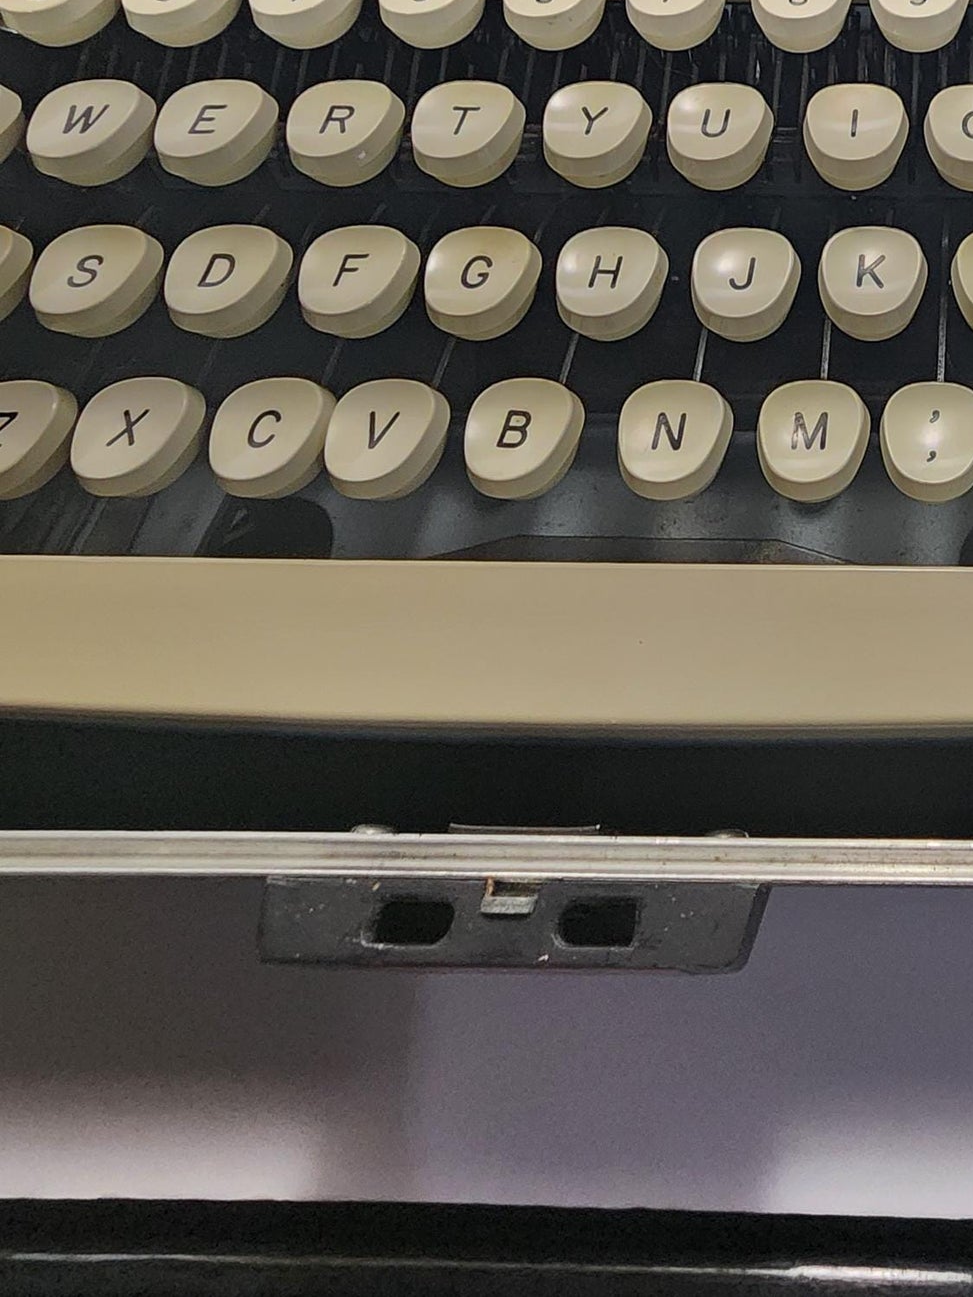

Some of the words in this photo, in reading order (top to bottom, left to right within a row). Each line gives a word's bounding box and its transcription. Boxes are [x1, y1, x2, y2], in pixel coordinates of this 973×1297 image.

[62, 104, 110, 135] W
[187, 104, 228, 135] E
[319, 105, 355, 134] R
[452, 105, 481, 136] T
[581, 106, 609, 136] Y
[701, 108, 731, 138] U
[67, 254, 104, 288] S
[197, 253, 236, 288] D
[332, 253, 370, 287] F
[460, 255, 493, 289] G
[587, 255, 624, 289] H
[728, 256, 757, 291] J
[856, 254, 886, 289] K
[106, 408, 151, 447] X
[247, 409, 282, 448] C
[367, 410, 401, 450] V
[496, 409, 532, 449] B
[651, 411, 687, 451] N
[791, 411, 829, 451] M
